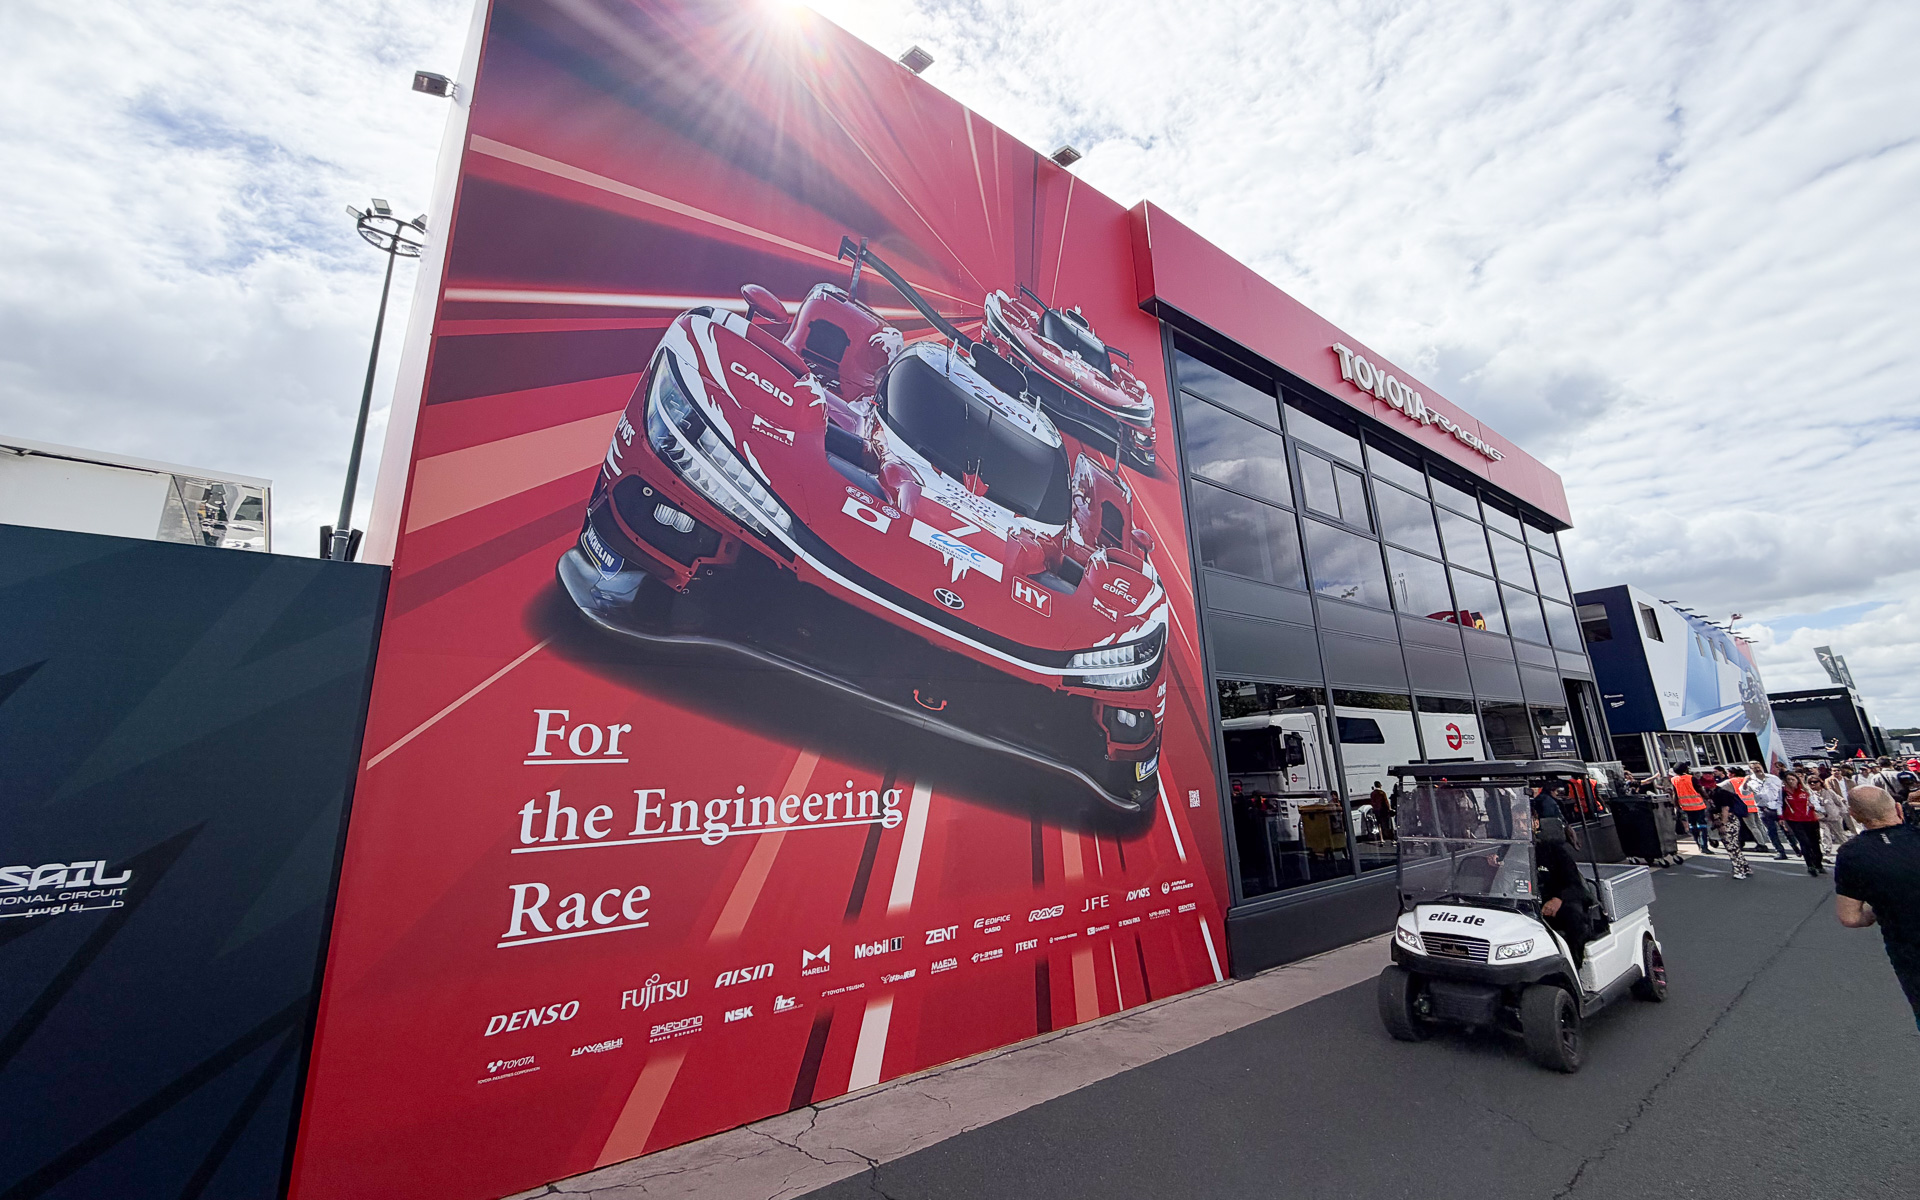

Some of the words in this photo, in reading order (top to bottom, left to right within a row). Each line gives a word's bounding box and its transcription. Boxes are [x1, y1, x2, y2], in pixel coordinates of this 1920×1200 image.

[730, 361, 794, 407] CASIO
[953, 371, 1031, 425] DENSO
[1333, 342, 1431, 427] TOYOTA
[1424, 406, 1507, 462] RACING
[751, 424, 793, 447] MARELLI
[947, 512, 982, 538] 7
[588, 527, 615, 568] MICHELIN
[931, 533, 987, 562] WEC
[1015, 581, 1049, 609] HY
[1102, 583, 1138, 606] EDIFICE
[1769, 694, 1843, 705] ORVETTE
[528, 708, 632, 757] For
[517, 789, 614, 845] the
[628, 779, 903, 846] Engineering
[1170, 879, 1186, 887] JAPAN
[1171, 882, 1194, 892] AIRLINES
[58, 887, 128, 901] CIRCUIT
[1081, 894, 1110, 913] JFE
[501, 881, 651, 938] Race
[1028, 904, 1065, 923] RAYS
[1428, 911, 1486, 927] eila.de
[984, 925, 1002, 934] CASIO
[985, 914, 1011, 926] EDIFICE
[925, 925, 959, 945] ZENT
[854, 938, 889, 960] Mobil
[1015, 938, 1038, 955] JTEKT
[801, 964, 830, 977] MARELLI
[931, 957, 958, 971] MAEDA
[714, 962, 775, 989] AISIN
[621, 975, 689, 1012] FUJITSU
[827, 987, 845, 996] TOYOTA
[484, 1000, 580, 1037] DENSO
[724, 1005, 754, 1023] NSK
[674, 1027, 702, 1038] EXPERTS
[570, 1037, 624, 1057] HAYASHI
[502, 1055, 535, 1070] TOYOTA
